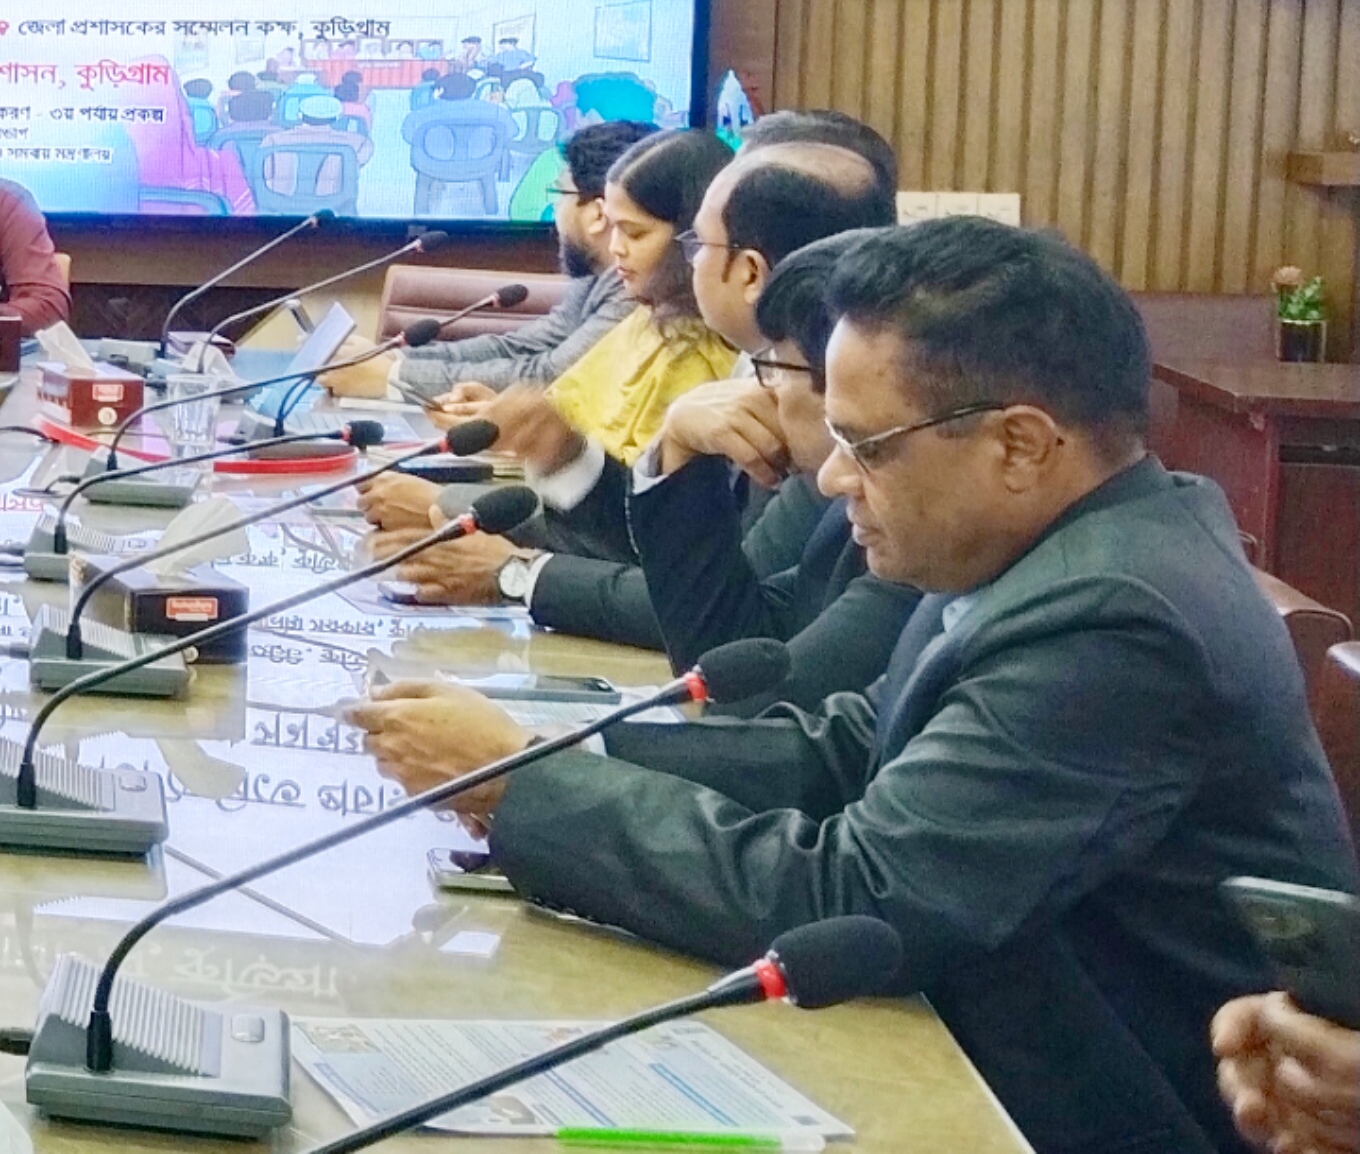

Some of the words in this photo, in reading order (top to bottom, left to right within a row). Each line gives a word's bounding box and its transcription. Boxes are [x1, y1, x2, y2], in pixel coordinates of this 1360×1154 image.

[18, 19, 65, 36] জেলা
[70, 19, 166, 36] প্রশাসকের
[173, 19, 249, 36] সম্মেলন
[311, 16, 391, 41] কুড়িগ্রাম
[74, 58, 171, 91] কুড়িগ্রাম
